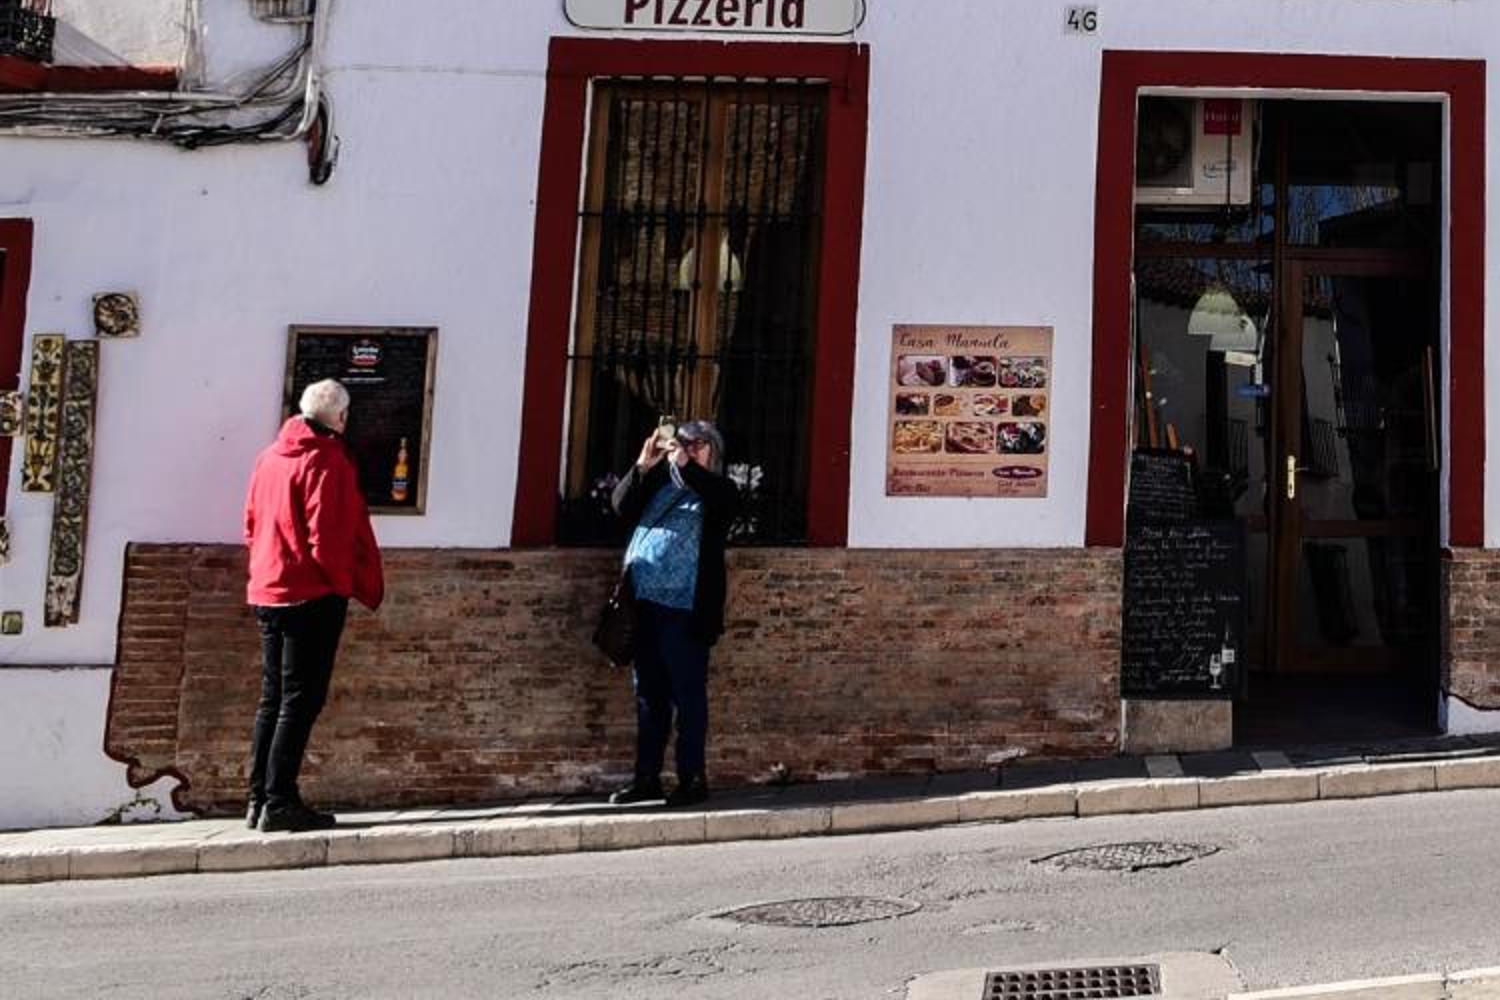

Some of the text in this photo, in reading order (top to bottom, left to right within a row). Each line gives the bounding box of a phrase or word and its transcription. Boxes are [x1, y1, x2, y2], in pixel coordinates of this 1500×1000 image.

[1067, 9, 1097, 31] 46
[900, 331, 1010, 349] Casa Manuela
